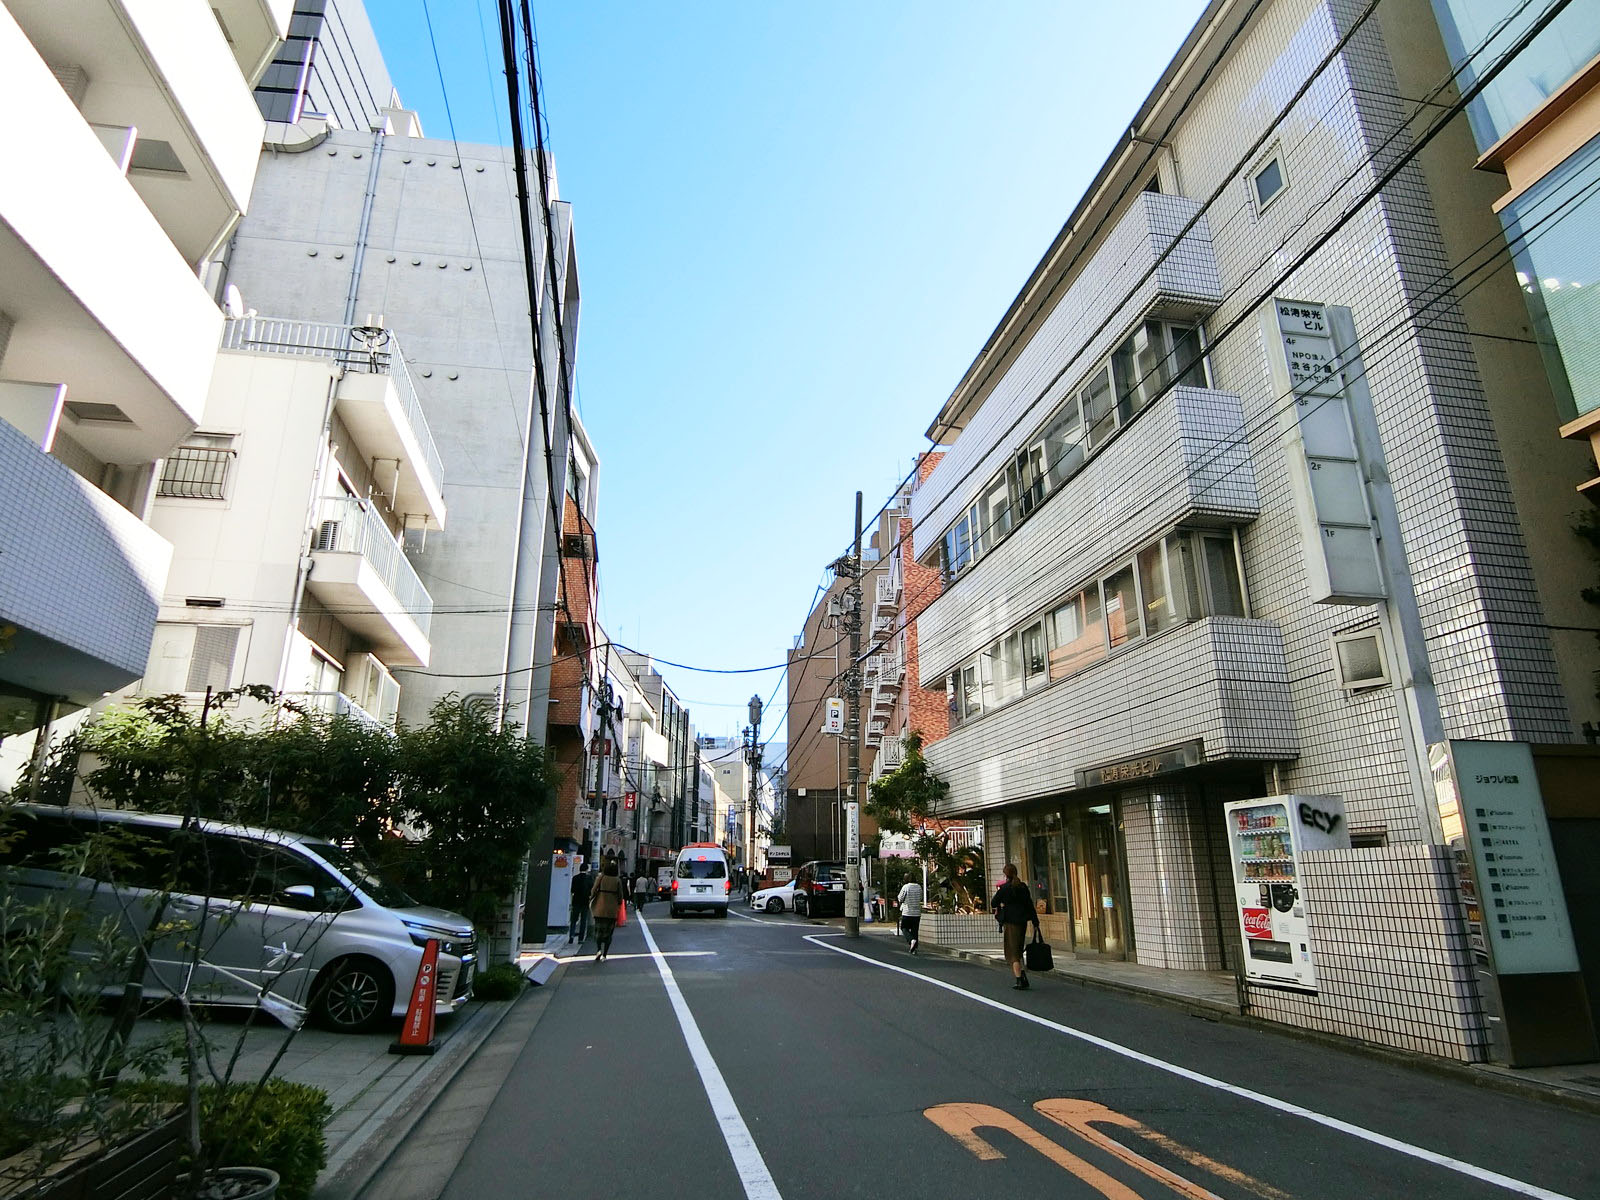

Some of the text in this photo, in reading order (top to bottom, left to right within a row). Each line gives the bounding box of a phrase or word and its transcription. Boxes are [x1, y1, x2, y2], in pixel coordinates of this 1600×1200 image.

[1303, 321, 1324, 331] ビル
[1292, 352, 1326, 361] NPO法人
[1291, 361, 1332, 373] 渋谷介護
[1299, 398, 1309, 406] 3F
[1311, 462, 1322, 471] 2F
[1325, 529, 1335, 537] 1F
